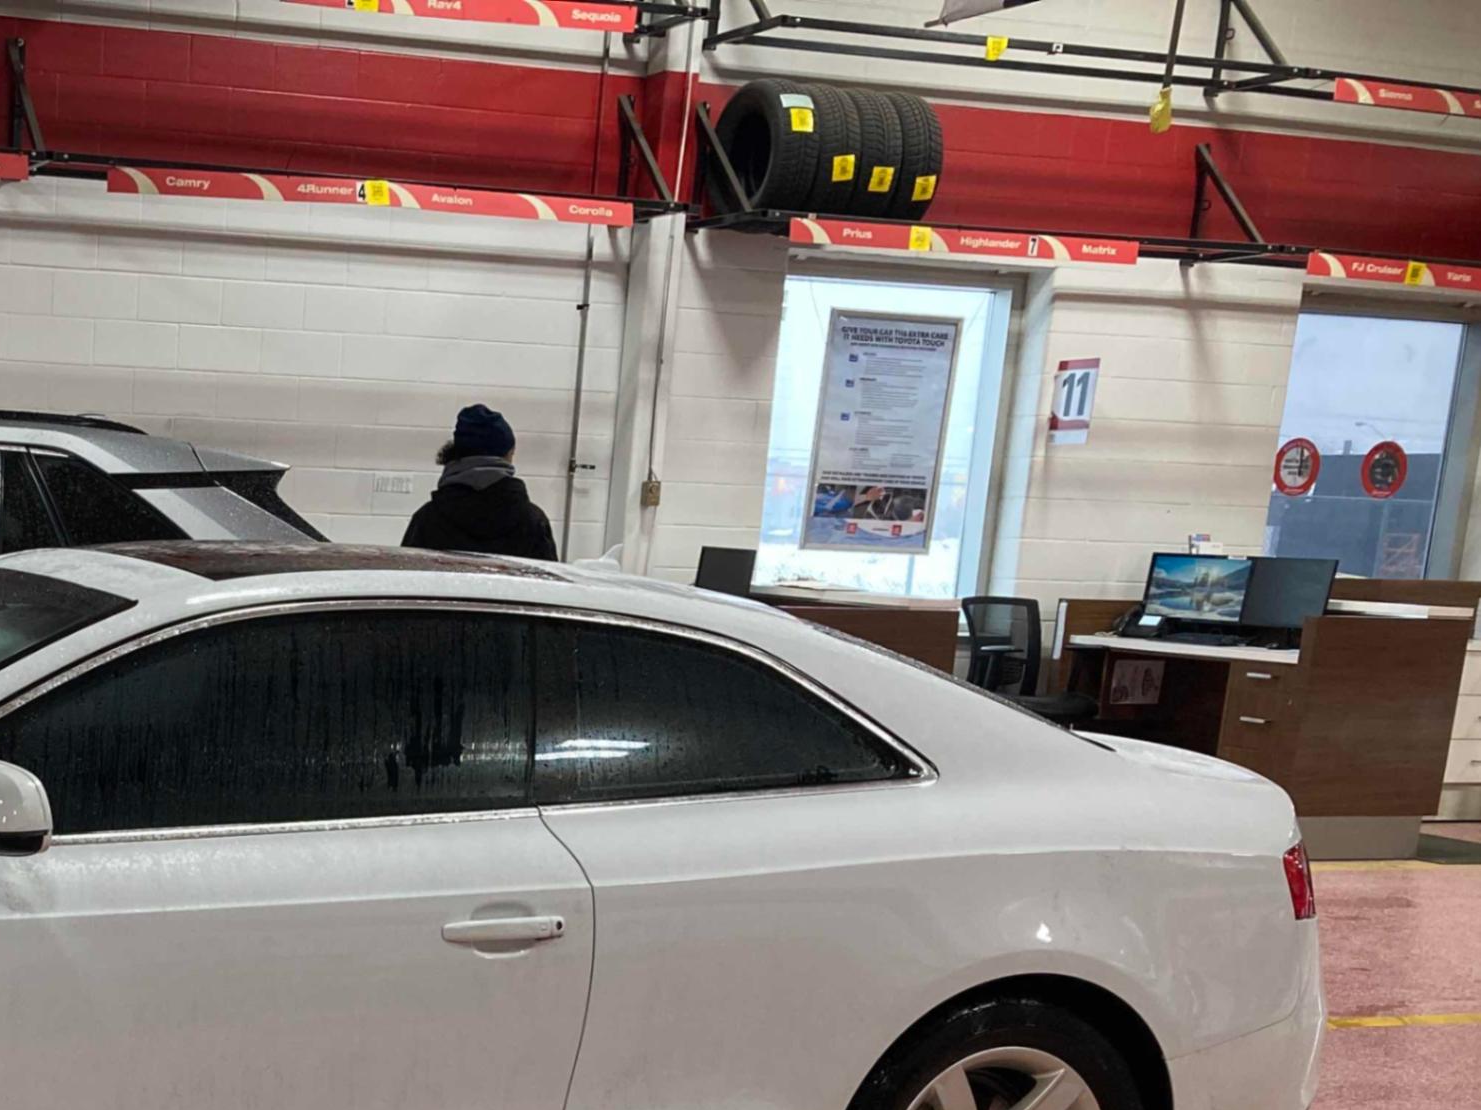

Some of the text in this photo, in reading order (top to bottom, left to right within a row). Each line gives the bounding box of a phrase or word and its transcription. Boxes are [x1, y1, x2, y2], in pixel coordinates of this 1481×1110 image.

[571, 9, 622, 23] Sequoia
[166, 176, 210, 191] Camry
[297, 184, 354, 196] 4Runner
[358, 183, 366, 201] 4
[431, 193, 473, 206] Avalon
[568, 204, 614, 217] Corolla
[842, 227, 873, 240] Prius
[960, 236, 1022, 251] Highlander
[1030, 238, 1037, 253] 7
[1082, 244, 1117, 256] Matrix
[1351, 262, 1365, 272] FJ
[1366, 263, 1404, 275] Cruiser
[875, 335, 893, 343] WITH
[895, 336, 920, 345] TOYOTA
[922, 338, 945, 347] TOUCH
[1062, 371, 1090, 417] 11
